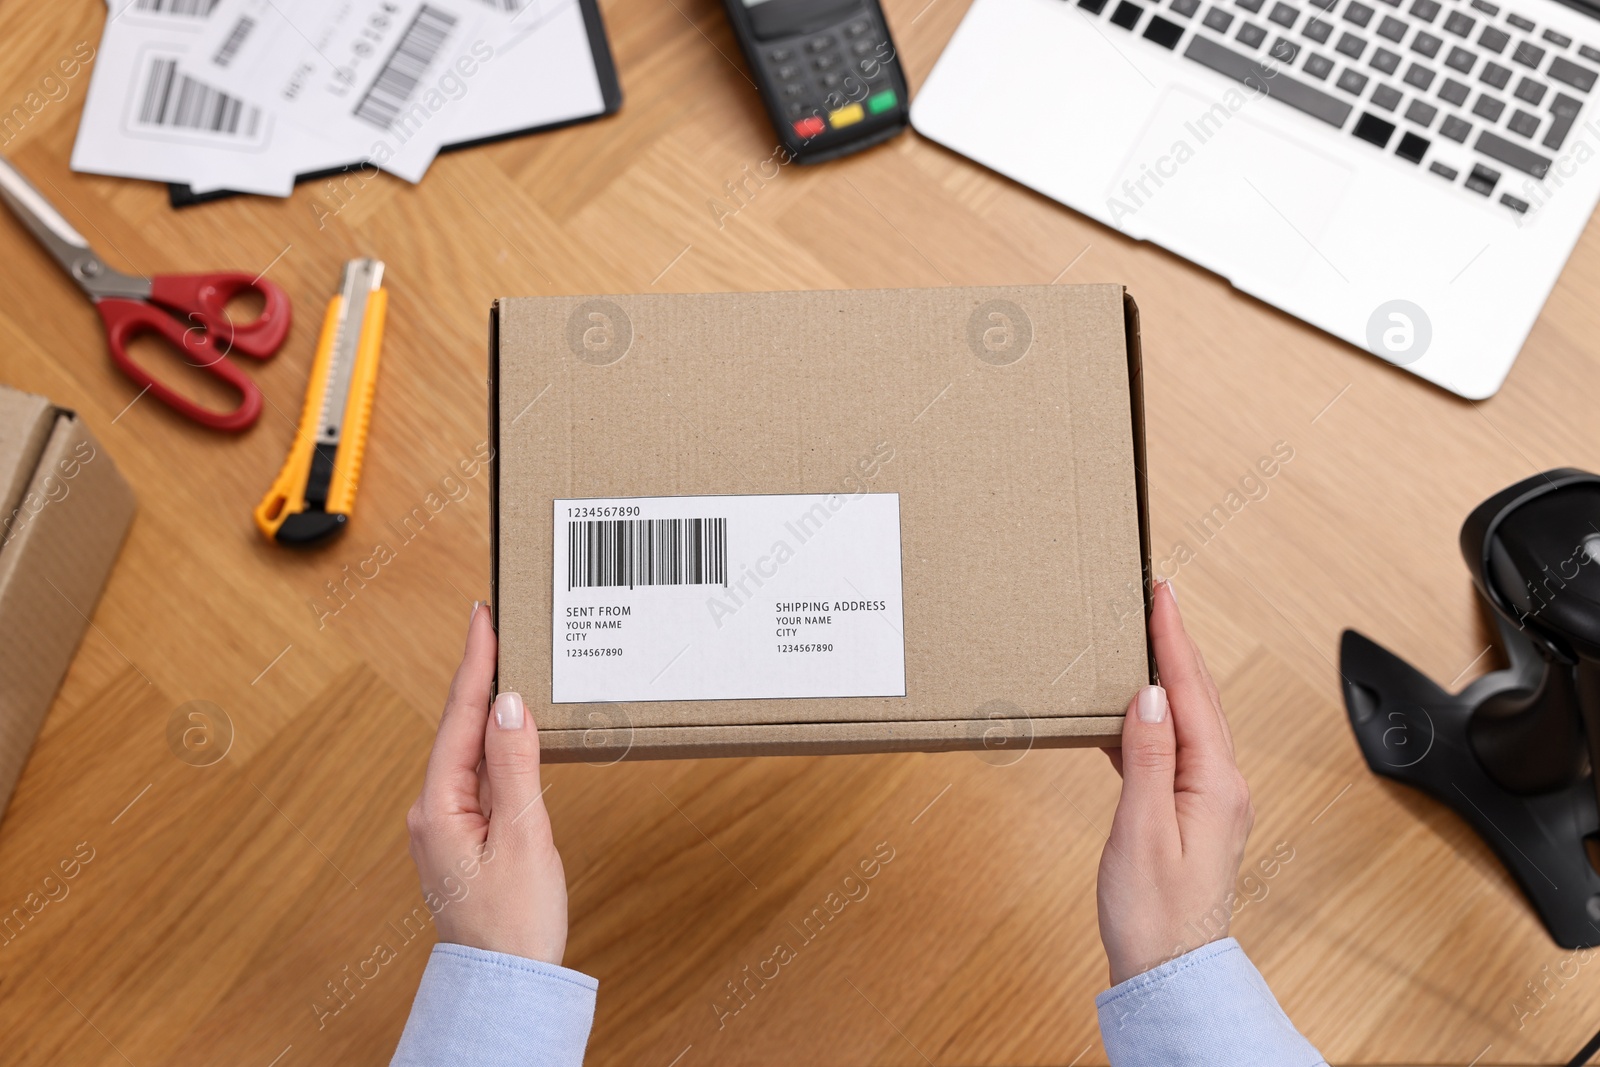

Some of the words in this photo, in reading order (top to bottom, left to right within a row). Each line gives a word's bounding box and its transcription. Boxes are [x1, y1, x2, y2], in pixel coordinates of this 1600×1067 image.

[567, 506, 640, 518] 1234567890
[775, 602, 830, 613] SHIPPING
[833, 600, 886, 611] ADDRESS
[566, 606, 595, 618] SENT
[598, 606, 632, 617] FROM
[566, 621, 592, 630] YOUR
[594, 620, 622, 629] NAME
[775, 616, 802, 625] YOUR
[804, 616, 832, 625] NAME
[565, 632, 588, 642] CITY
[775, 628, 798, 637] CITY
[566, 647, 623, 657] 1234567890
[777, 643, 834, 653] 1234567890
